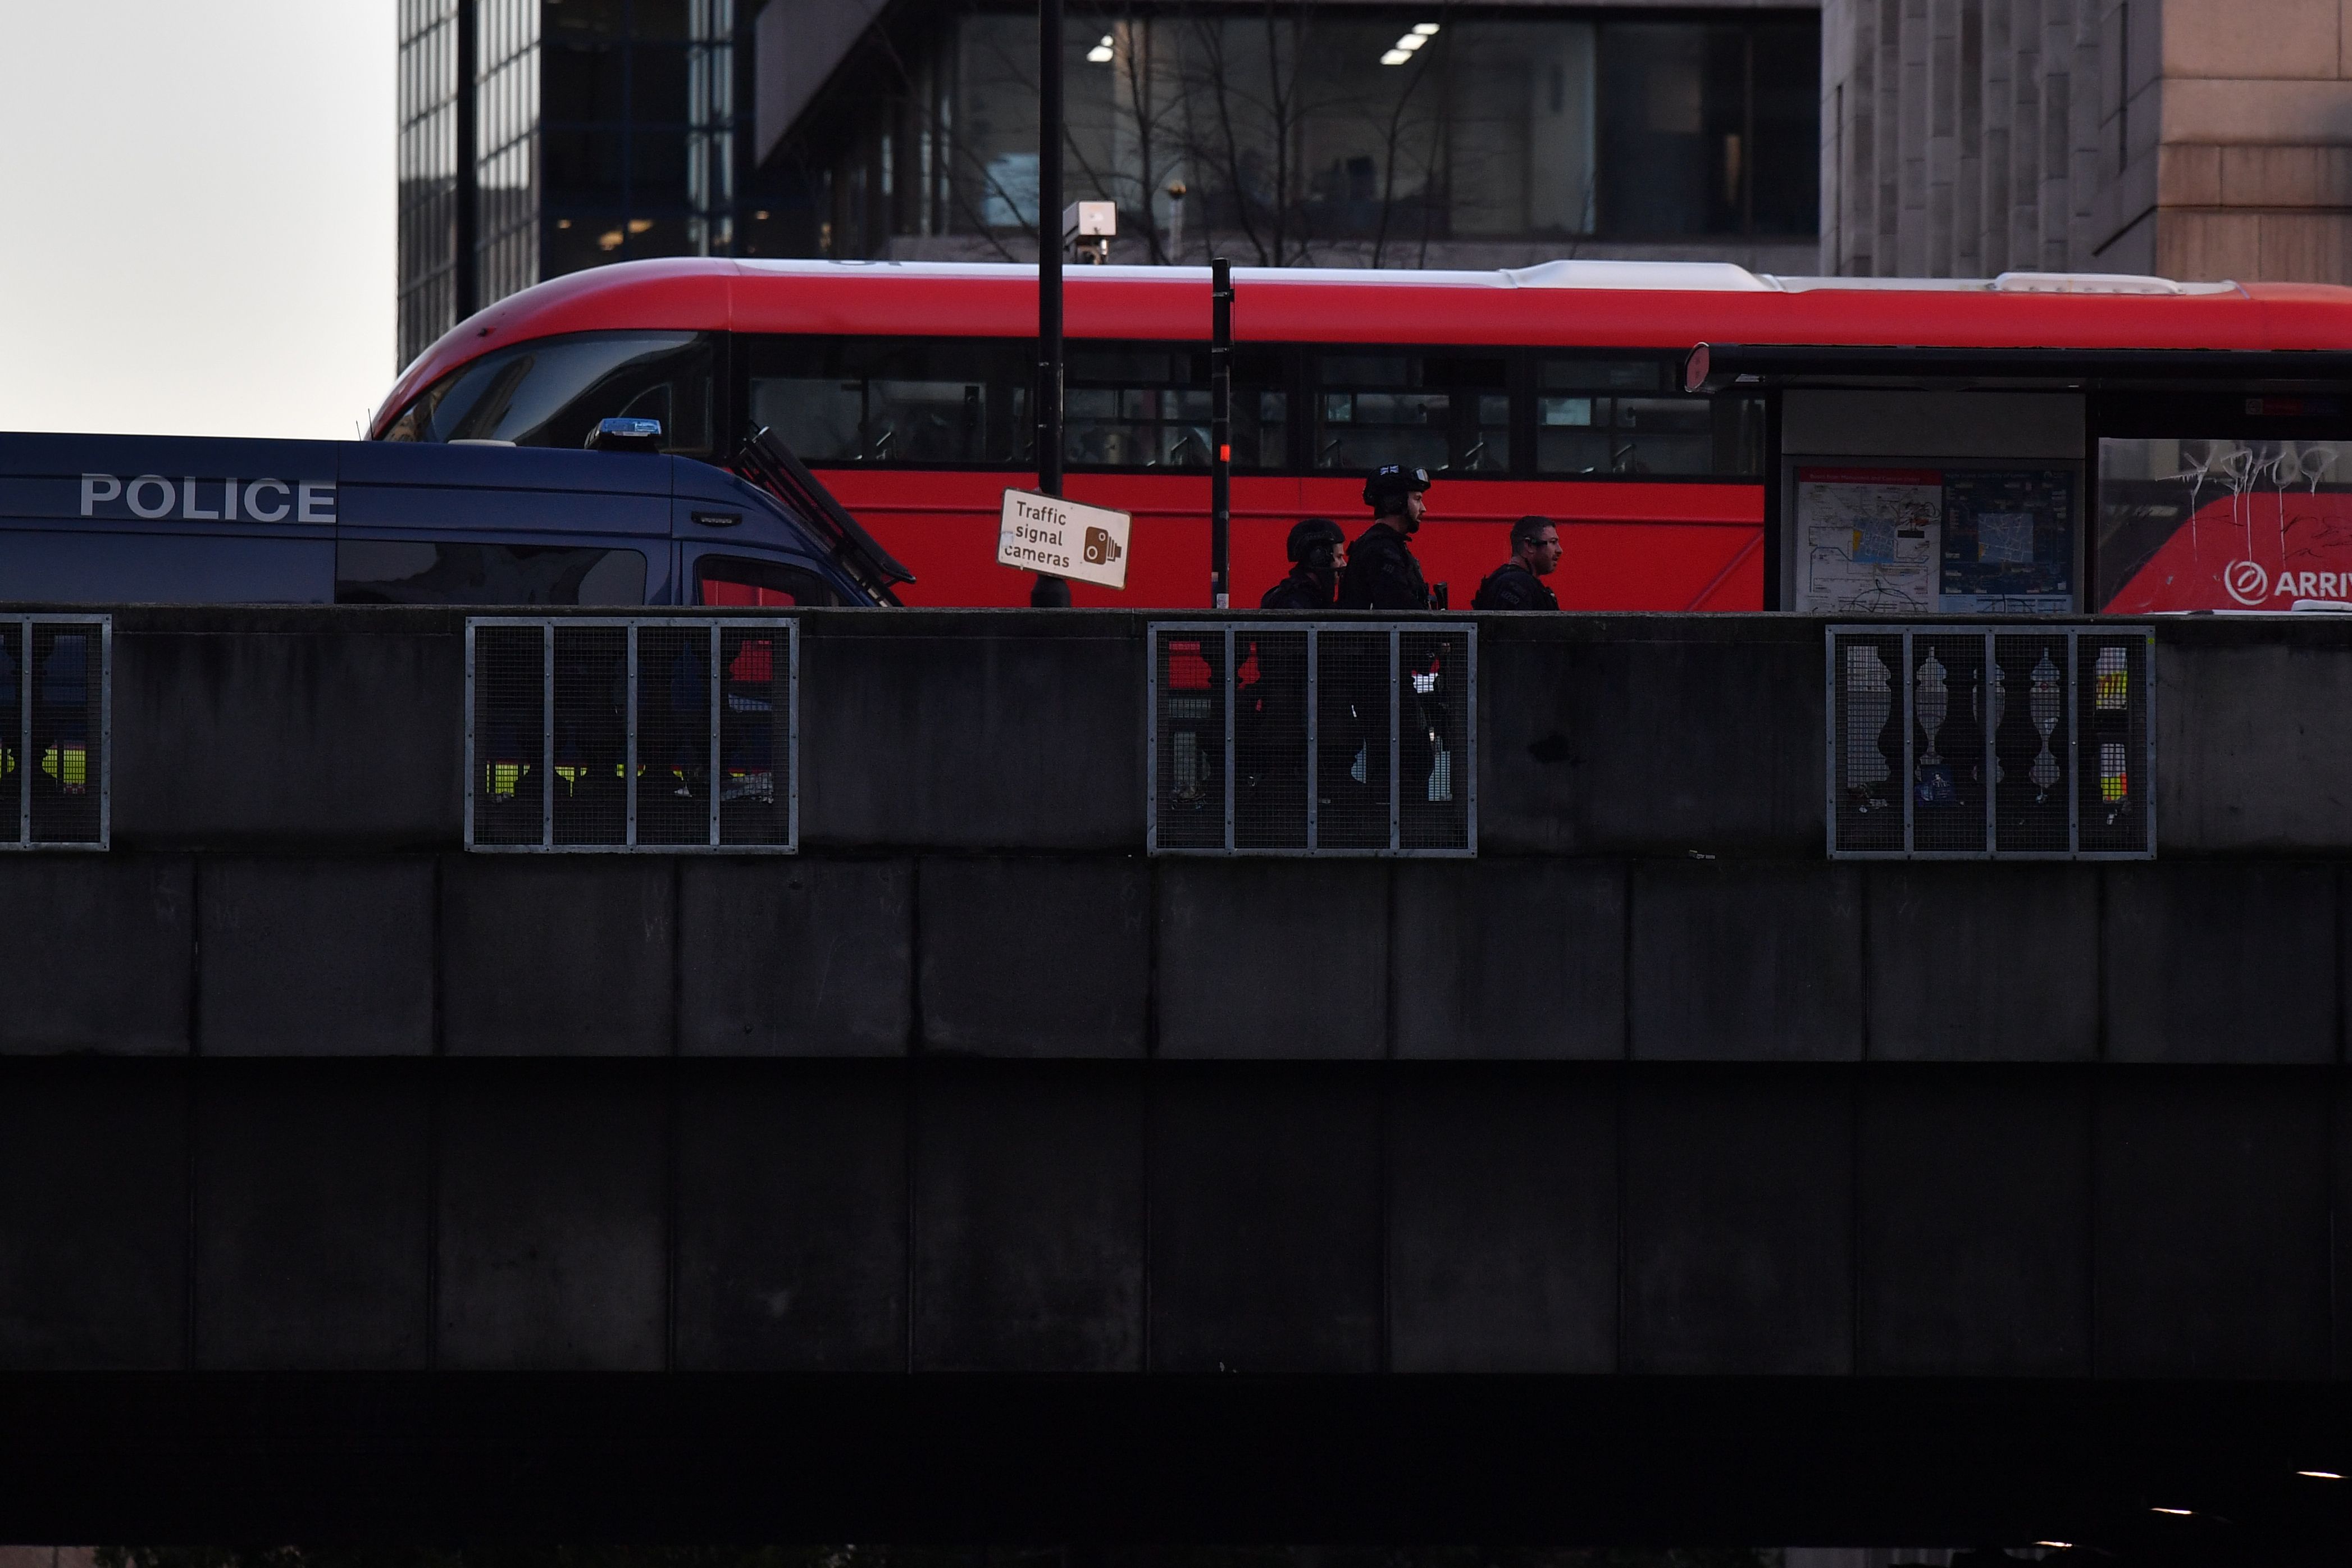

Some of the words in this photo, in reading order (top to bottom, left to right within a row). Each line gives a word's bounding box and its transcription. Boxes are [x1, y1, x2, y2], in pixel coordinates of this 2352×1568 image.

[80, 472, 336, 523] POLICE
[1017, 500, 1066, 526] Traffic
[1015, 523, 1063, 546] signal
[1004, 545, 1070, 568] cameras
[2274, 571, 2352, 598] ARRI
